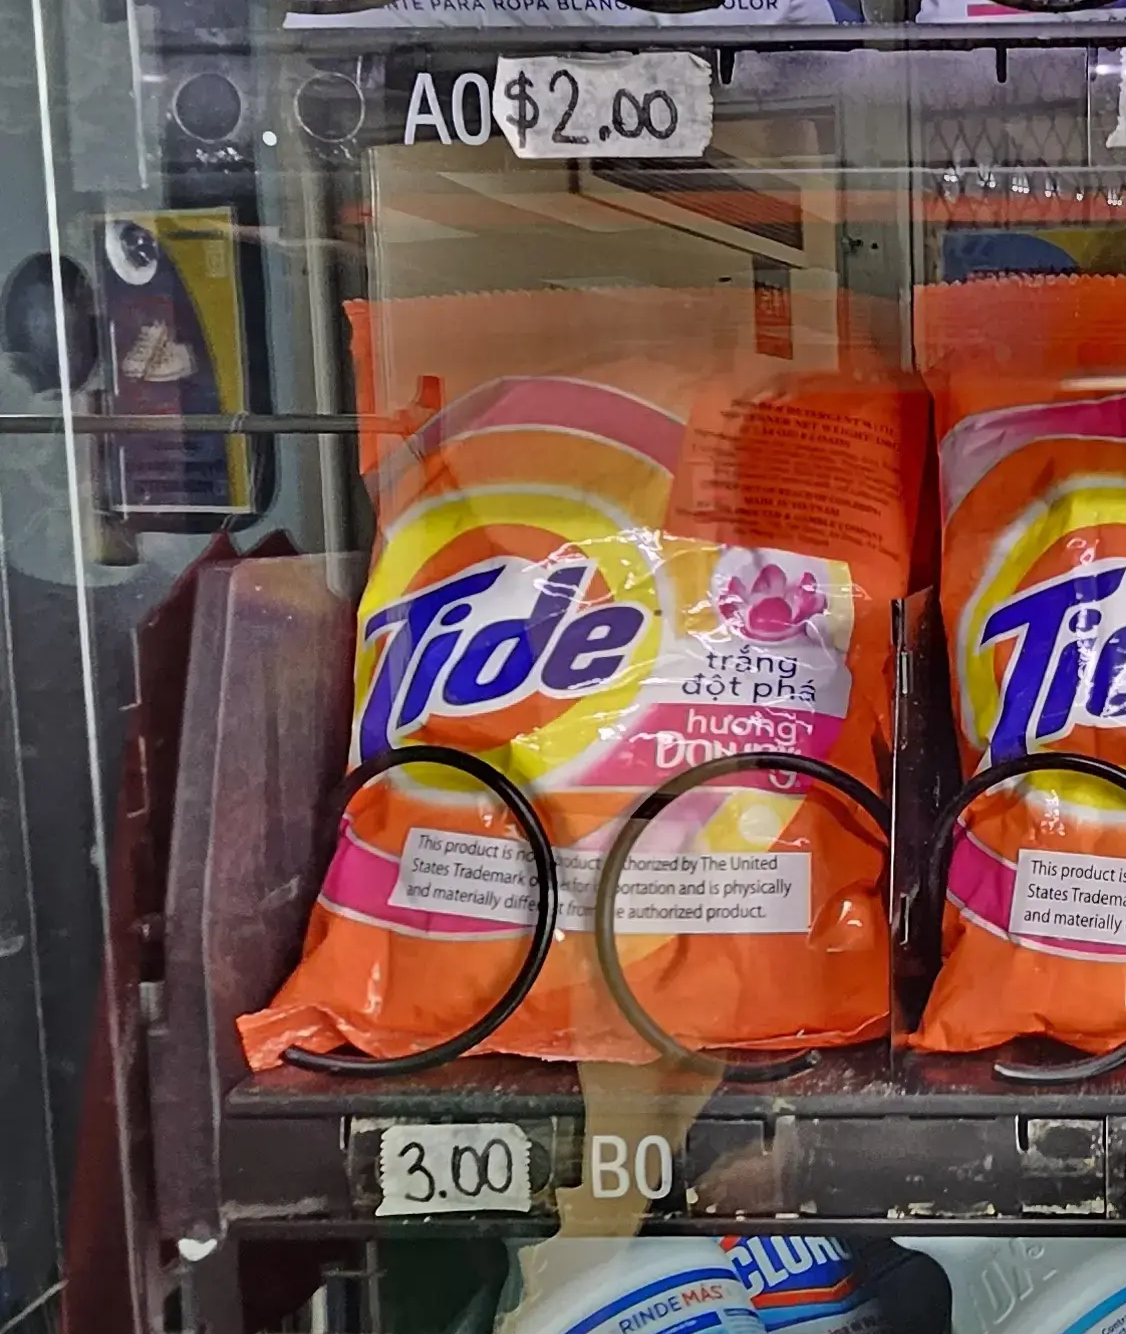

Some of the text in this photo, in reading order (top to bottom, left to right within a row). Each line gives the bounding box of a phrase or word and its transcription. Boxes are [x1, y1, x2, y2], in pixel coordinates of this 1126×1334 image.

[404, 71, 492, 146] A0
[504, 68, 679, 150] $2.00
[358, 563, 645, 766] Tide
[417, 834, 778, 874] This product is by The United
[1030, 859, 1058, 877] This
[1060, 863, 1116, 883] product
[412, 857, 793, 899] States Trademark and is physically
[1026, 882, 1068, 902] States
[406, 882, 767, 923] and materially authorized product.
[1023, 908, 1051, 924] and
[1053, 911, 1123, 935] materially
[401, 1139, 514, 1202] 3.00
[589, 1135, 674, 1200] B0
